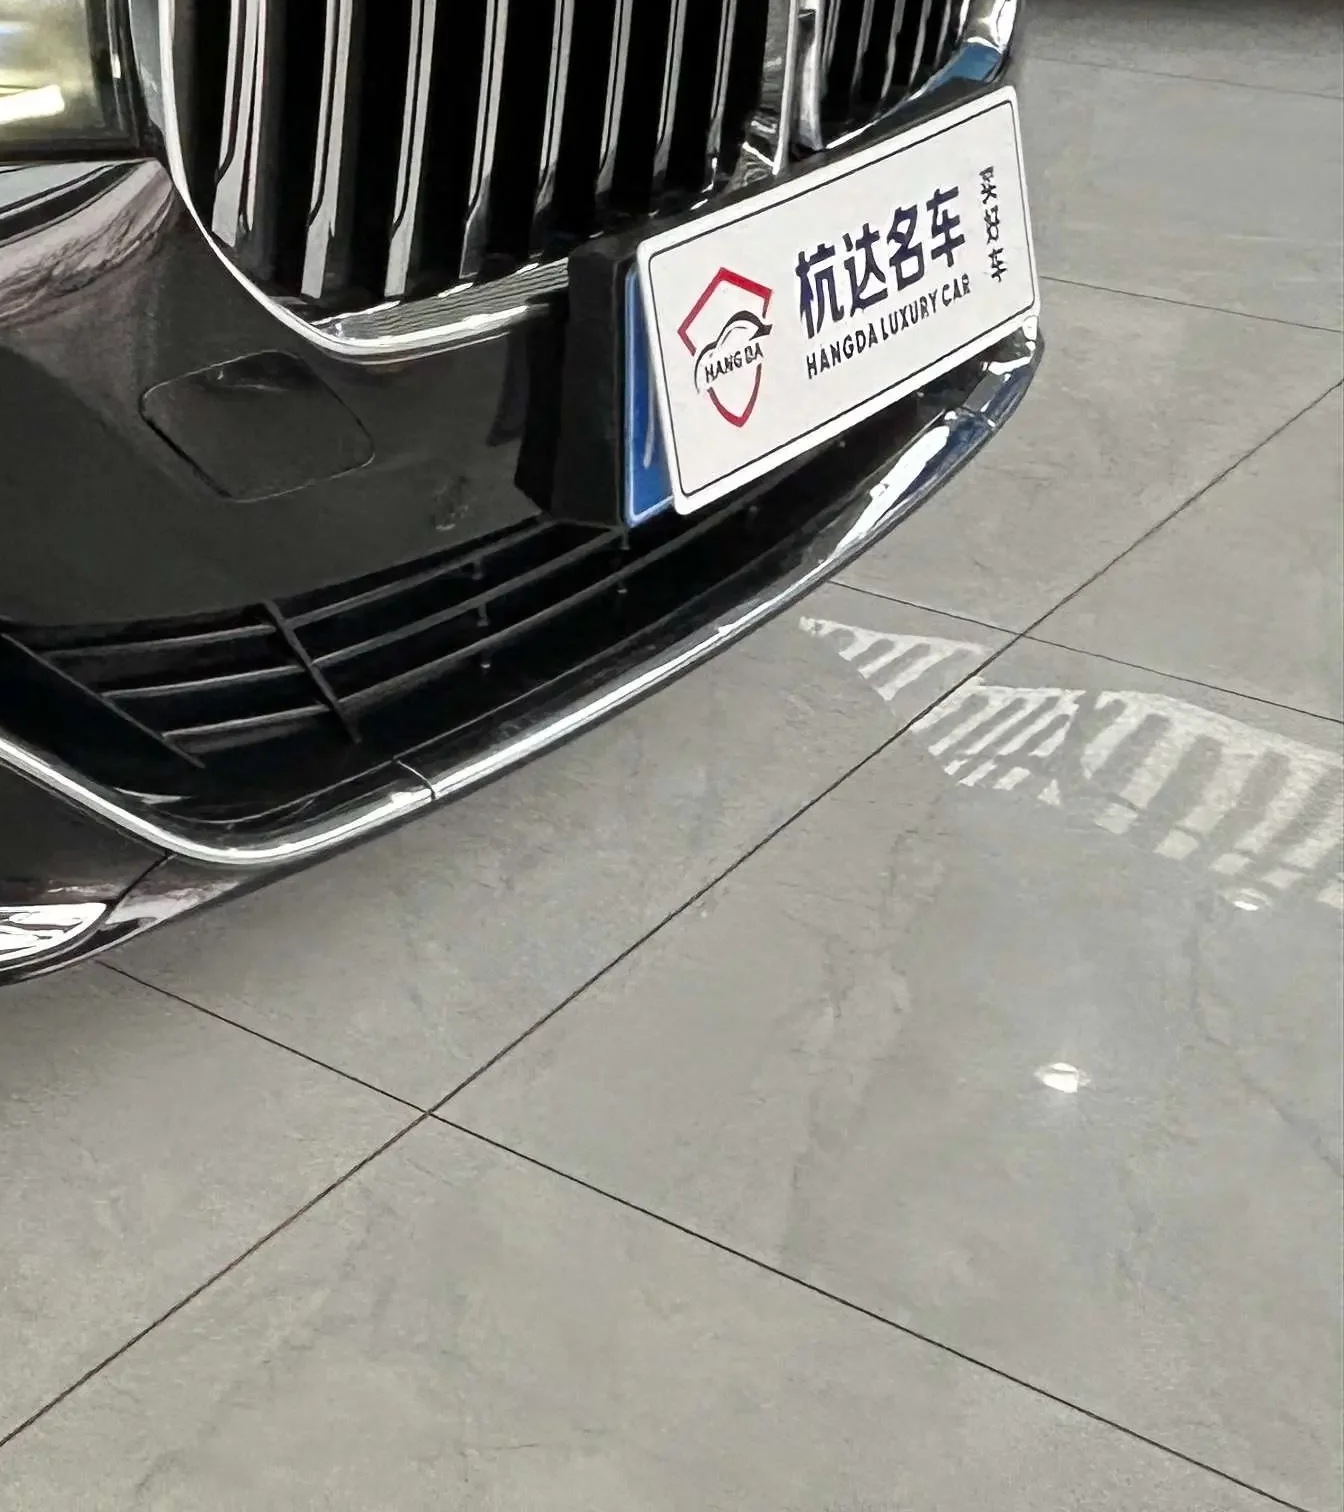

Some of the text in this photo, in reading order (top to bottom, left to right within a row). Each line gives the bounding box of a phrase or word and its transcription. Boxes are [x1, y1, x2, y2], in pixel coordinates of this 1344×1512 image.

[796, 186, 965, 338] 杭达名车
[882, 296, 938, 341] LUXURY
[941, 272, 971, 307] CAR
